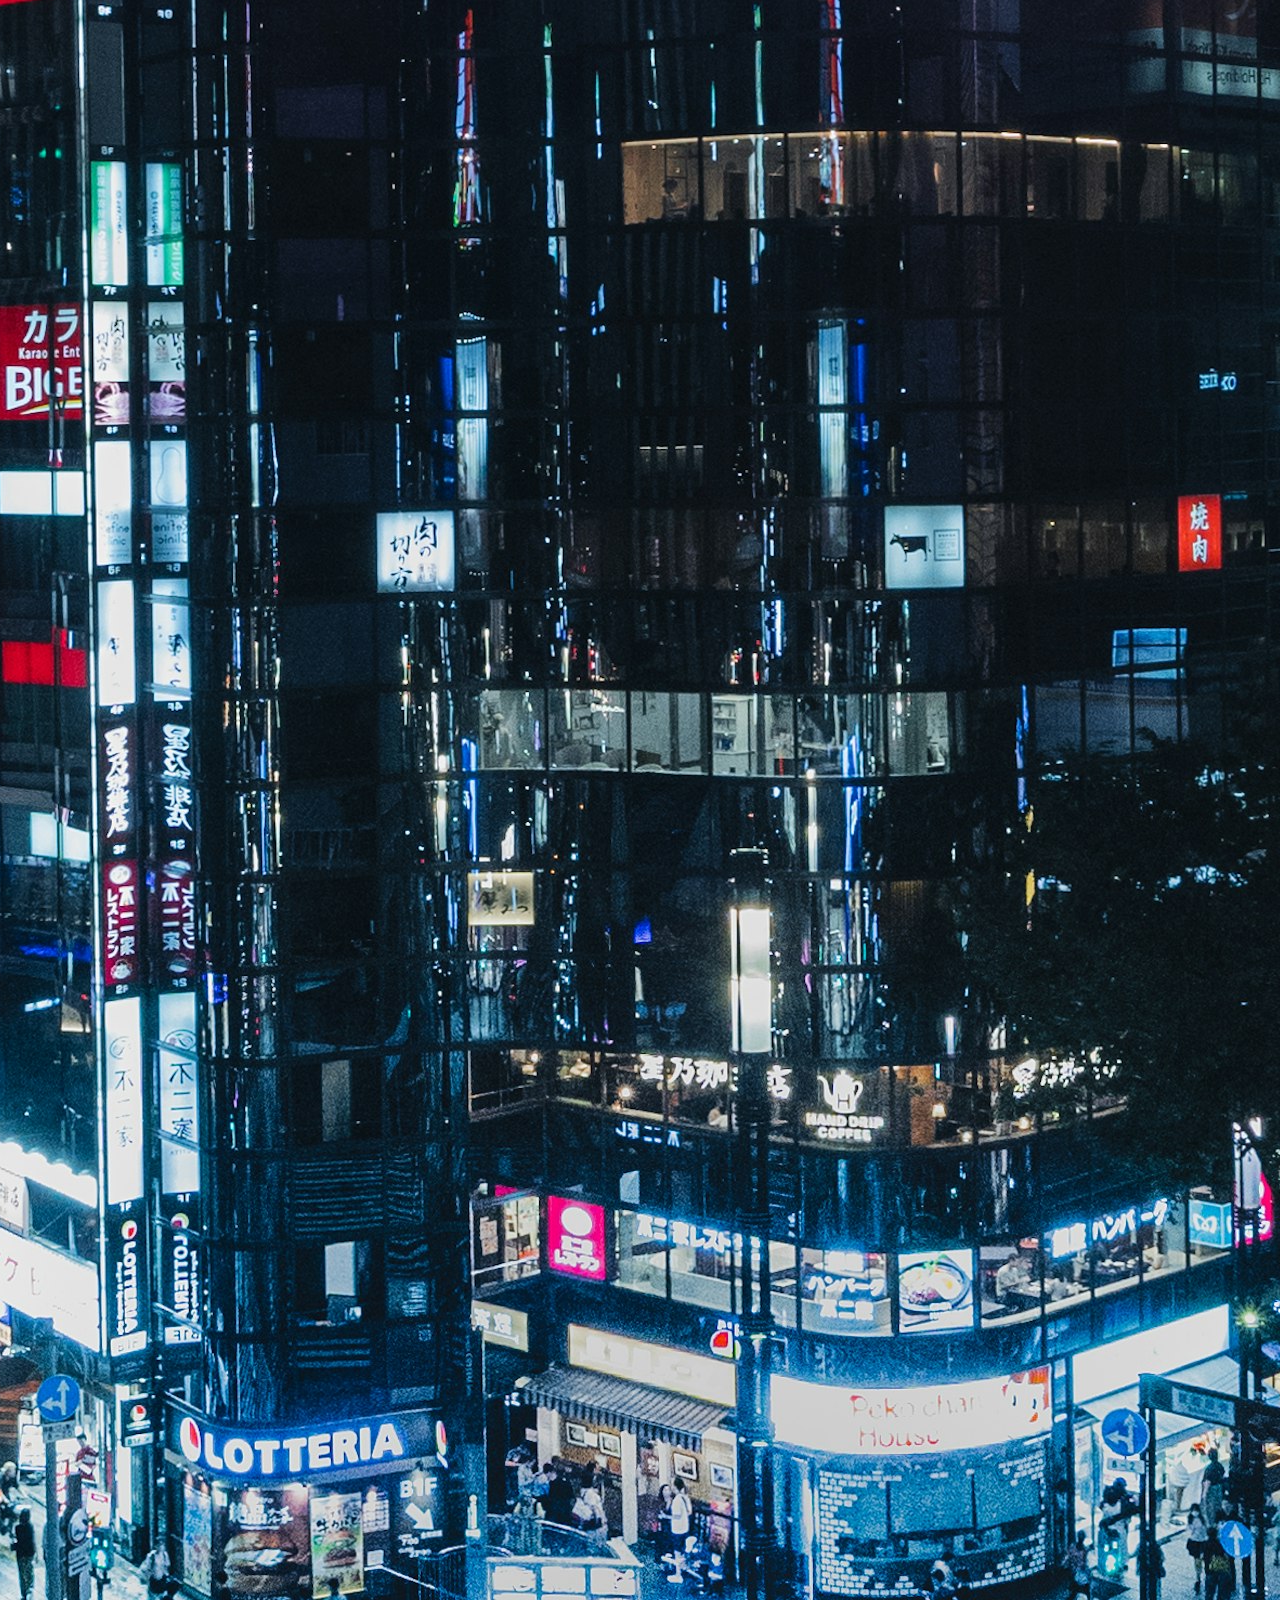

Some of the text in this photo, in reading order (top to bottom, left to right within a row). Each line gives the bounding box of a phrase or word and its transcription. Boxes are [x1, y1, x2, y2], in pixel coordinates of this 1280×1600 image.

[103, 286, 117, 296] 7F
[18, 346, 60, 360] Karaoe
[413, 515, 438, 559] 肉の
[1189, 501, 1209, 564] 焼肉
[107, 888, 119, 959] レストラン
[118, 885, 136, 957] 不二家
[115, 984, 129, 994] 2F
[639, 1053, 794, 1100] 星乃珈店
[114, 1070, 134, 1148] 不二家
[805, 1112, 884, 1130] HAND DRIP
[816, 1126, 872, 1143] COFFEE
[119, 1202, 132, 1213] 1F
[122, 1240, 138, 1334] LOTTERIA
[807, 1276, 885, 1297] ハンバーグ
[203, 1422, 403, 1474] LOTTERIA
[400, 1477, 438, 1499] B1F
